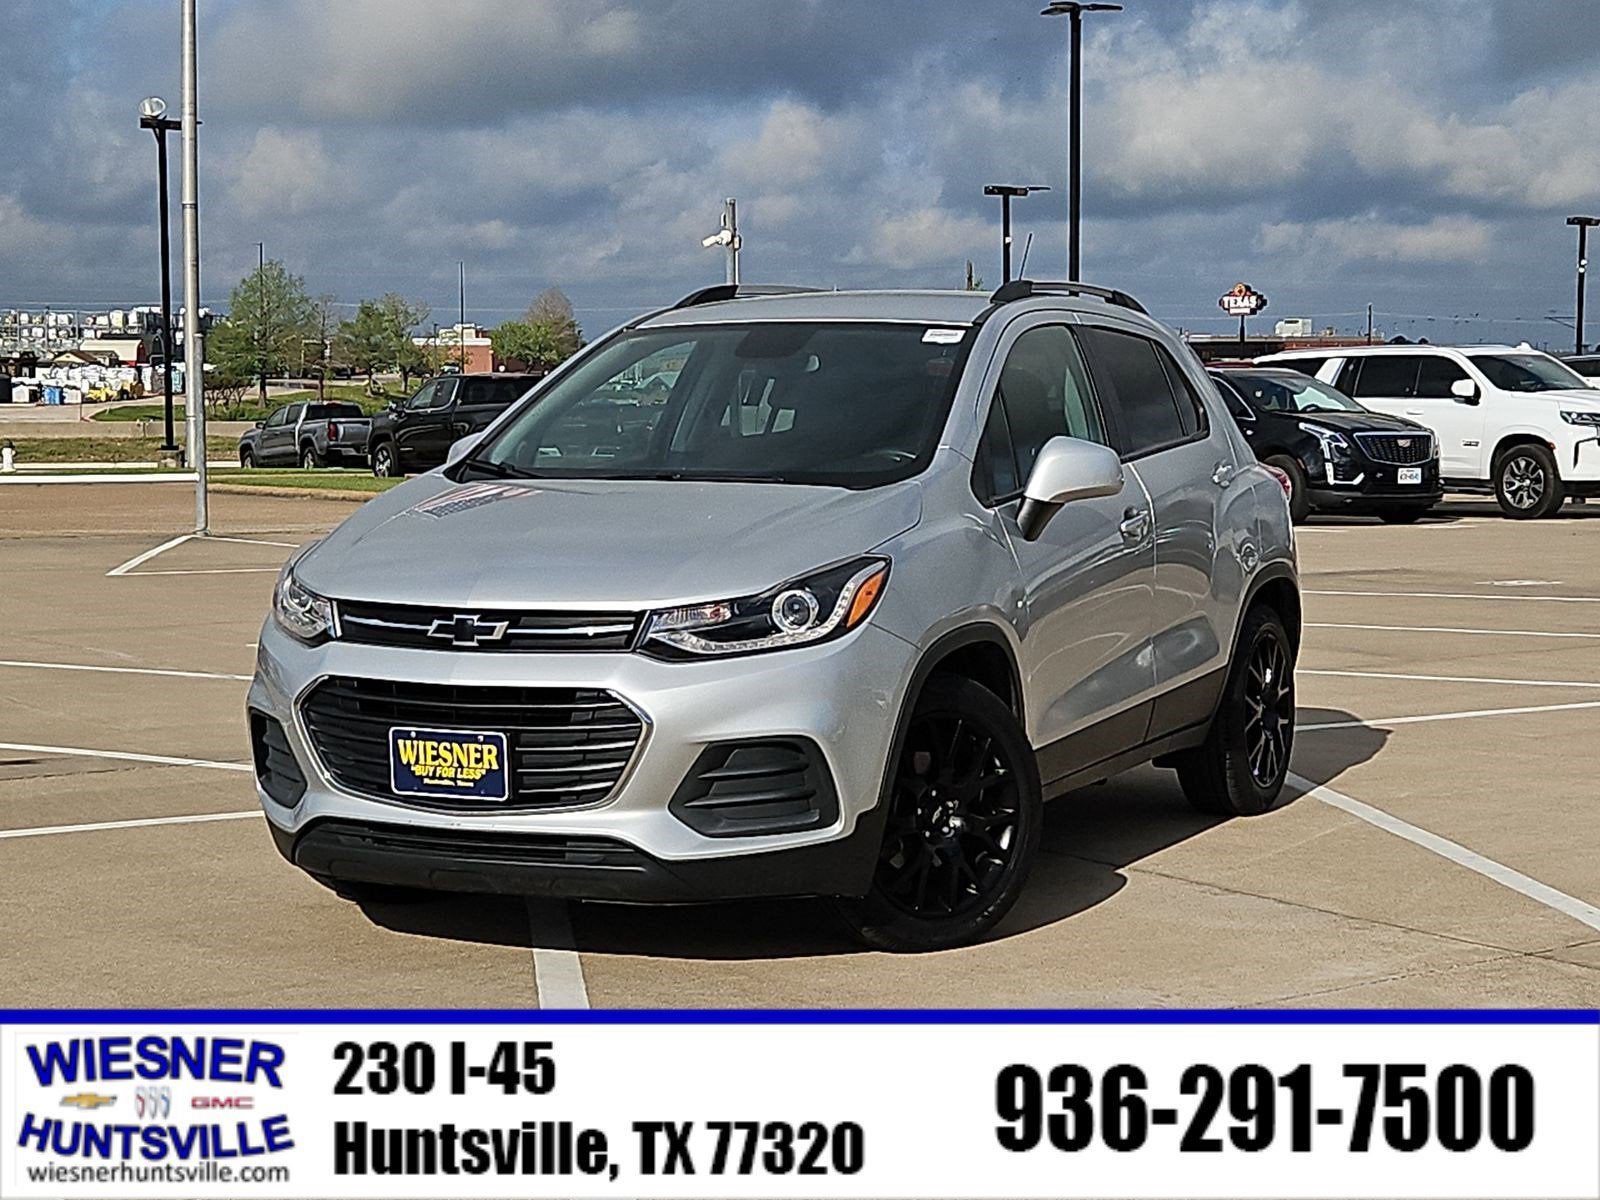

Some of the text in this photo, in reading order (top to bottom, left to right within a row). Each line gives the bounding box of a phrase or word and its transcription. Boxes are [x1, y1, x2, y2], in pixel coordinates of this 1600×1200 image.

[1222, 295, 1257, 308] TEXAS
[397, 738, 499, 770] WIESNER
[436, 766, 456, 778] FOR
